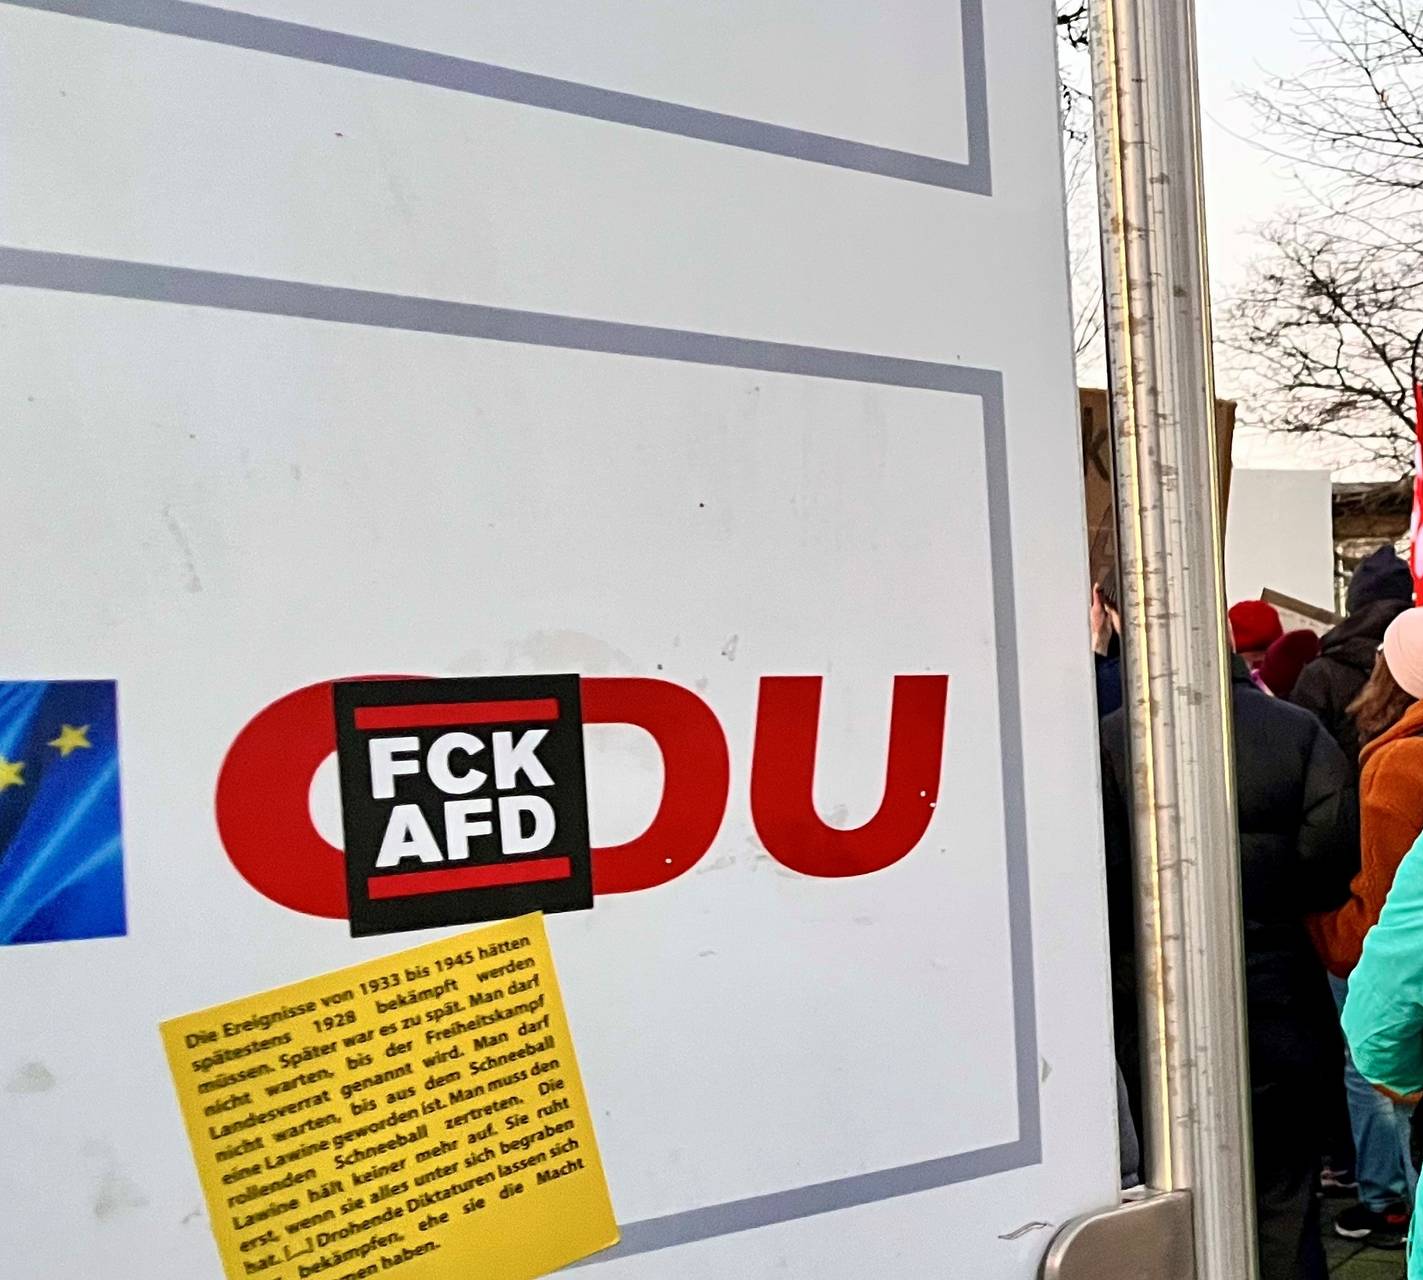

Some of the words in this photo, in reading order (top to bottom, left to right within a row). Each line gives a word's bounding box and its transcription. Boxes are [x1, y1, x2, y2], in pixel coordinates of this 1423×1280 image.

[215, 674, 949, 919] CDU
[369, 729, 556, 800] FCK
[374, 795, 557, 868] AFD
[185, 1031, 218, 1049] Die
[222, 1002, 316, 1038] Ereignisse
[320, 990, 354, 1007] von
[360, 973, 401, 995] 1933
[404, 966, 430, 982] bis
[434, 951, 474, 972] 1945
[477, 937, 531, 960] hätten
[192, 1032, 292, 1073] spätestens
[313, 1010, 357, 1033] 1928
[375, 979, 459, 1014] bekämpft
[476, 957, 535, 983] werden
[278, 1042, 337, 1069] Später
[342, 1030, 374, 1047] war
[379, 1023, 398, 1036] es
[400, 1015, 421, 1030] zu
[425, 1001, 466, 1023] spät.
[468, 989, 504, 1007] Man
[508, 973, 539, 995] darf
[204, 1092, 252, 1117] nicht
[345, 1053, 373, 1070] bis
[385, 1041, 413, 1057] der
[425, 994, 544, 1044] Freiheitskampf
[209, 1090, 331, 1140] Landesverrat
[340, 1063, 413, 1100] genannt
[422, 1045, 465, 1068] wird.
[473, 1032, 509, 1051] Man
[518, 1014, 549, 1036] darf
[215, 1137, 265, 1162] nicht
[350, 1098, 377, 1116] bis
[386, 1086, 416, 1104] aus
[424, 1071, 461, 1091] dem
[469, 1035, 555, 1076] Schneeball
[222, 1164, 262, 1185] eine
[264, 1140, 330, 1170] Lawine
[332, 1109, 419, 1150] geworden
[421, 1098, 448, 1115] ist.
[448, 1086, 485, 1105] Man
[487, 1070, 528, 1092] muss
[530, 1059, 560, 1076] den
[227, 1169, 317, 1208] rollenden
[334, 1124, 428, 1170] Schneeball
[538, 1079, 564, 1096] Die
[233, 1199, 300, 1230] Lawine
[307, 1181, 345, 1203] hält
[351, 1159, 406, 1186] keiner
[415, 1140, 458, 1163] mehr
[468, 1123, 498, 1144] auf.
[505, 1114, 529, 1130] Sie
[537, 1098, 570, 1119] ruht
[285, 1210, 336, 1234] wenn
[340, 1198, 366, 1215] sie
[370, 1181, 409, 1204] alles
[414, 1162, 459, 1186] unter
[464, 1147, 496, 1168] sich
[499, 1120, 574, 1155] begraben
[316, 1207, 404, 1248] Drohende
[406, 1172, 496, 1213] Diktaturen
[497, 1152, 547, 1178] lassen
[549, 1137, 579, 1158] sich
[418, 1212, 449, 1231] ehe
[463, 1198, 485, 1214] sie
[499, 1183, 524, 1199] die
[536, 1158, 585, 1185] Macht
[380, 1241, 441, 1269] haben.
